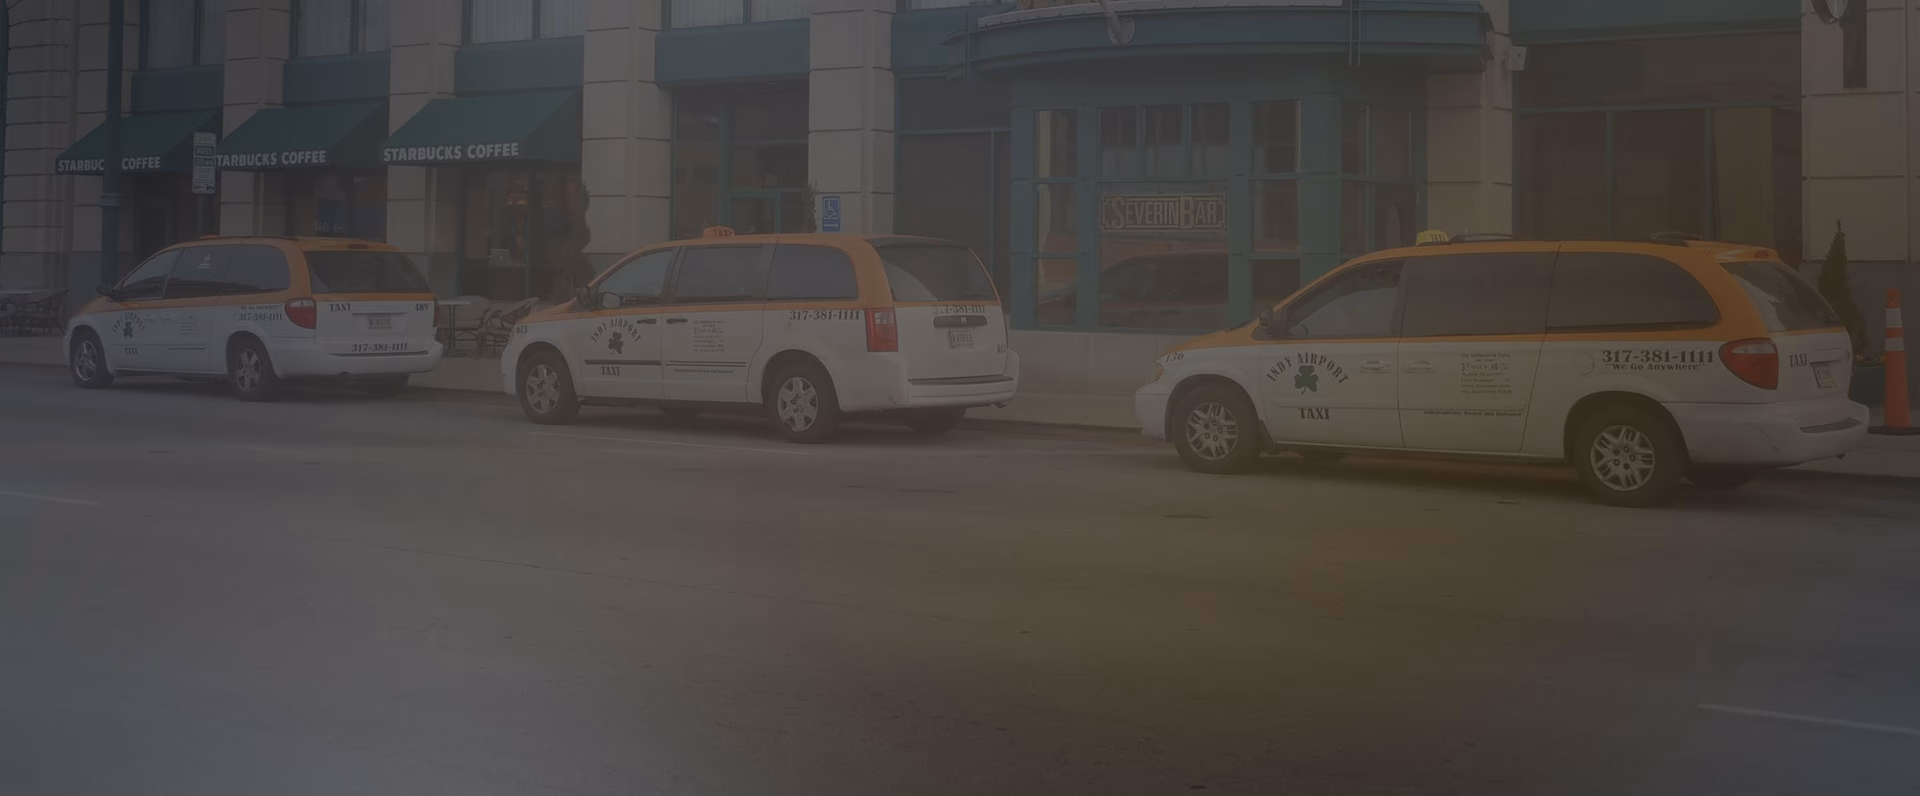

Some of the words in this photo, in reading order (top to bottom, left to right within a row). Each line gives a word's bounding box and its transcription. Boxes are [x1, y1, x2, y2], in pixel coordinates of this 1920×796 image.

[383, 144, 462, 162] STARBUCKS
[467, 142, 519, 159] COFFEE
[57, 158, 105, 172] STARBUC
[121, 156, 161, 170] COFFEE
[215, 152, 278, 167] TARBUCKS
[281, 150, 327, 165] COFFEE
[328, 302, 351, 312] TAXI
[414, 303, 429, 311] 489
[931, 304, 985, 314] 37-381-1111
[238, 312, 283, 322] 317-381-1111
[788, 310, 860, 321] 317-381-1111
[610, 318, 642, 342] AIRPORT
[351, 342, 408, 352] 317-381-1111
[1601, 349, 1713, 363] 317-381-1111
[1788, 353, 1808, 368] TAXI
[601, 366, 620, 376] TAXI
[1266, 355, 1293, 383] INDY
[1297, 352, 1350, 384] AIRPORT
[1630, 362, 1644, 371] Go
[1298, 407, 1330, 420] TAXI
